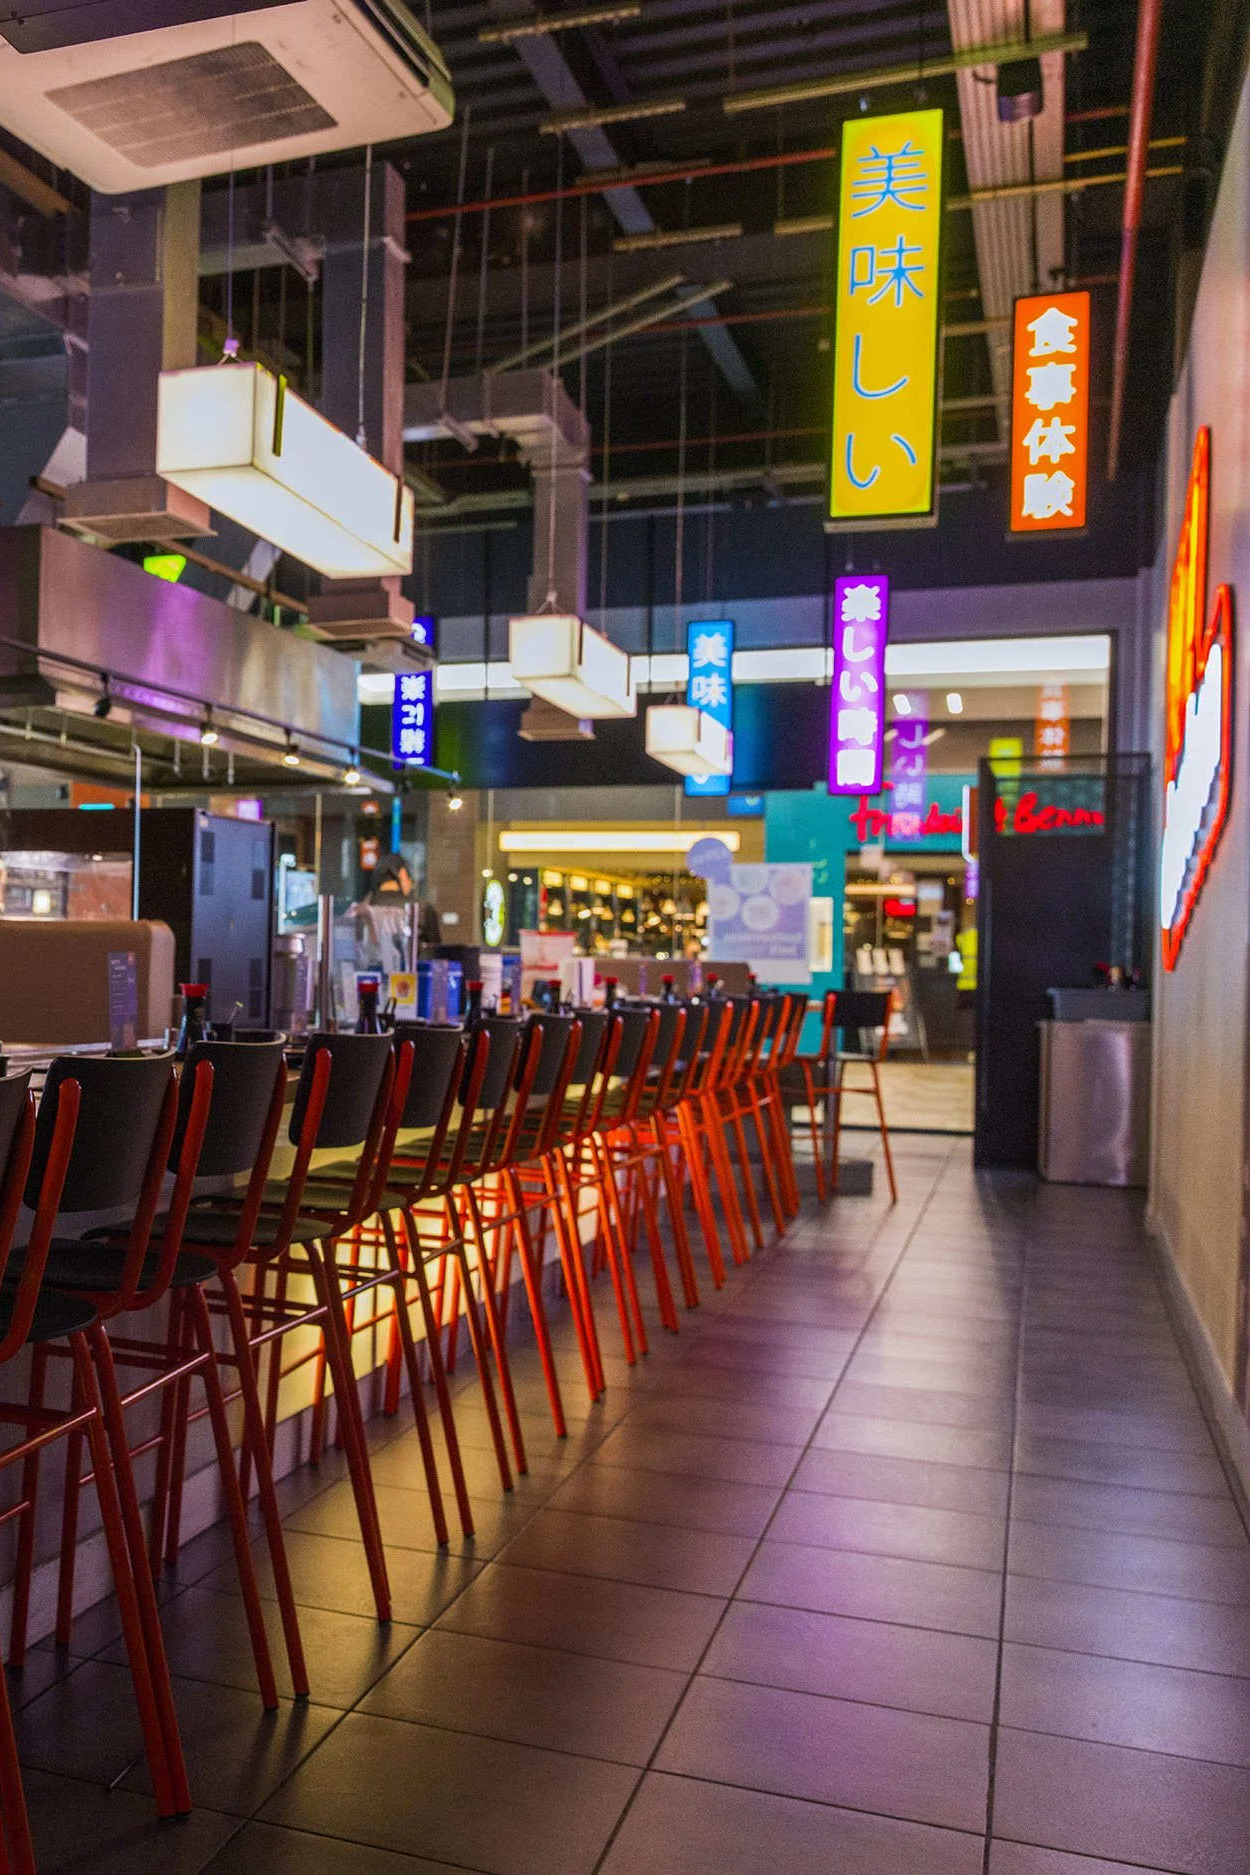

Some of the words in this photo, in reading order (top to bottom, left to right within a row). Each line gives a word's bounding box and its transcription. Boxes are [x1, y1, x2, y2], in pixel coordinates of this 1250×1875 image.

[846, 139, 928, 490] 美味しい
[1021, 307, 1079, 519] 食事体験
